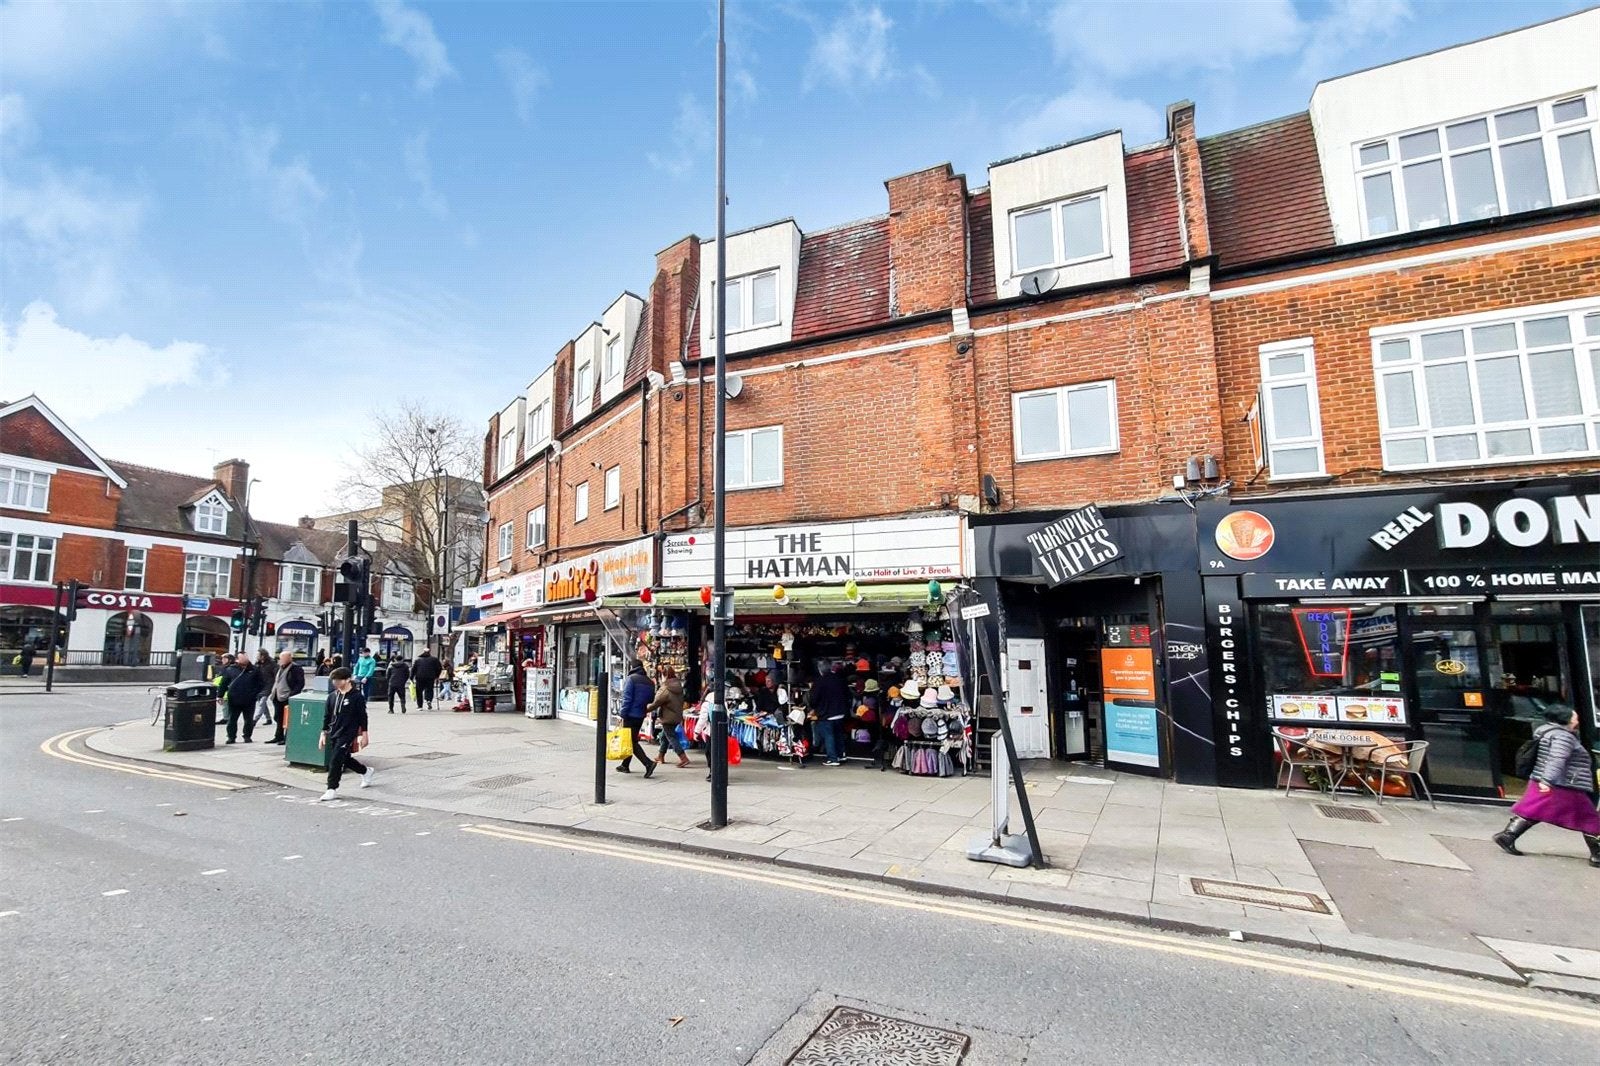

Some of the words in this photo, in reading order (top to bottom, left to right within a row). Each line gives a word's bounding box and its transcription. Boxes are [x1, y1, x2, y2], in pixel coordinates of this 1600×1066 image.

[1026, 505, 1104, 555] TURNPIKE
[1370, 505, 1434, 551] REAL
[667, 547, 693, 555] Showing
[774, 532, 822, 554] THE
[1038, 528, 1119, 583] VAPES
[1209, 560, 1225, 569] 9A
[748, 555, 851, 579] HATMAN
[873, 568, 892, 577] Halit
[902, 567, 919, 576] Live
[921, 566, 927, 575] 2
[928, 565, 952, 575] Break
[1275, 579, 1326, 591] TAKE
[1331, 577, 1390, 590] AWAY
[1424, 575, 1461, 588] 100
[1466, 574, 1486, 587] %
[1491, 573, 1557, 586] HOME
[87, 593, 153, 608] COSTA
[1307, 612, 1338, 622] REAL
[1218, 604, 1237, 684] BURGERS
[1319, 623, 1332, 673] DONER
[1225, 698, 1243, 757] CHIPS
